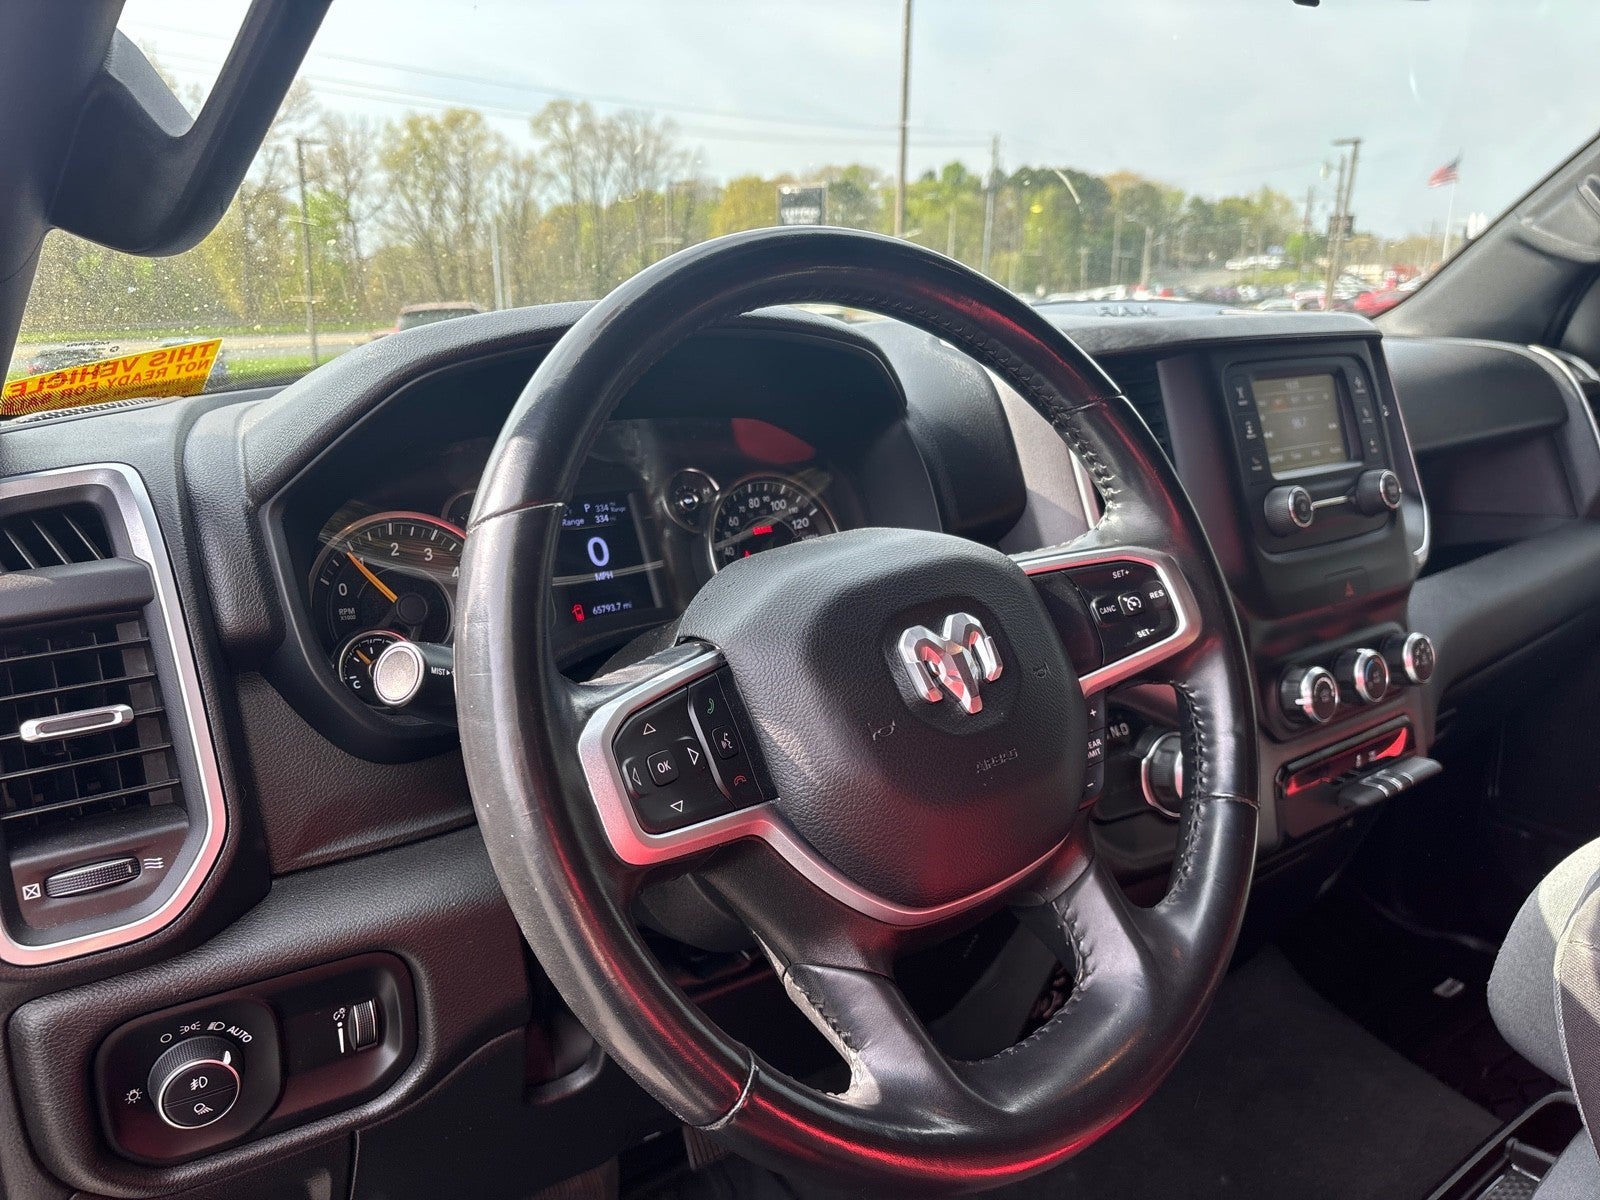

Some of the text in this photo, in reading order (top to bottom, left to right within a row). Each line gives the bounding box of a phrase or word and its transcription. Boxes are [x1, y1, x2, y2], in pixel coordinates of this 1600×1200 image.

[584, 504, 591, 512] P
[749, 498, 760, 509] 80
[770, 499, 787, 511] 100
[562, 515, 609, 526] Range 334
[728, 516, 739, 527] 60
[792, 517, 810, 530] 120
[390, 542, 399, 556] 2
[424, 548, 433, 561] 3
[587, 536, 610, 567] 0
[452, 566, 459, 579] 4
[594, 571, 614, 581] MPH
[338, 582, 347, 596] 0
[1149, 590, 1164, 600] RES
[338, 607, 356, 615] RPM
[592, 603, 621, 615] 65793.7
[1099, 605, 1117, 615] CANC
[431, 666, 446, 676] MIST
[353, 679, 361, 690] C
[657, 759, 672, 774] OK
[226, 1025, 253, 1043] AUTO
